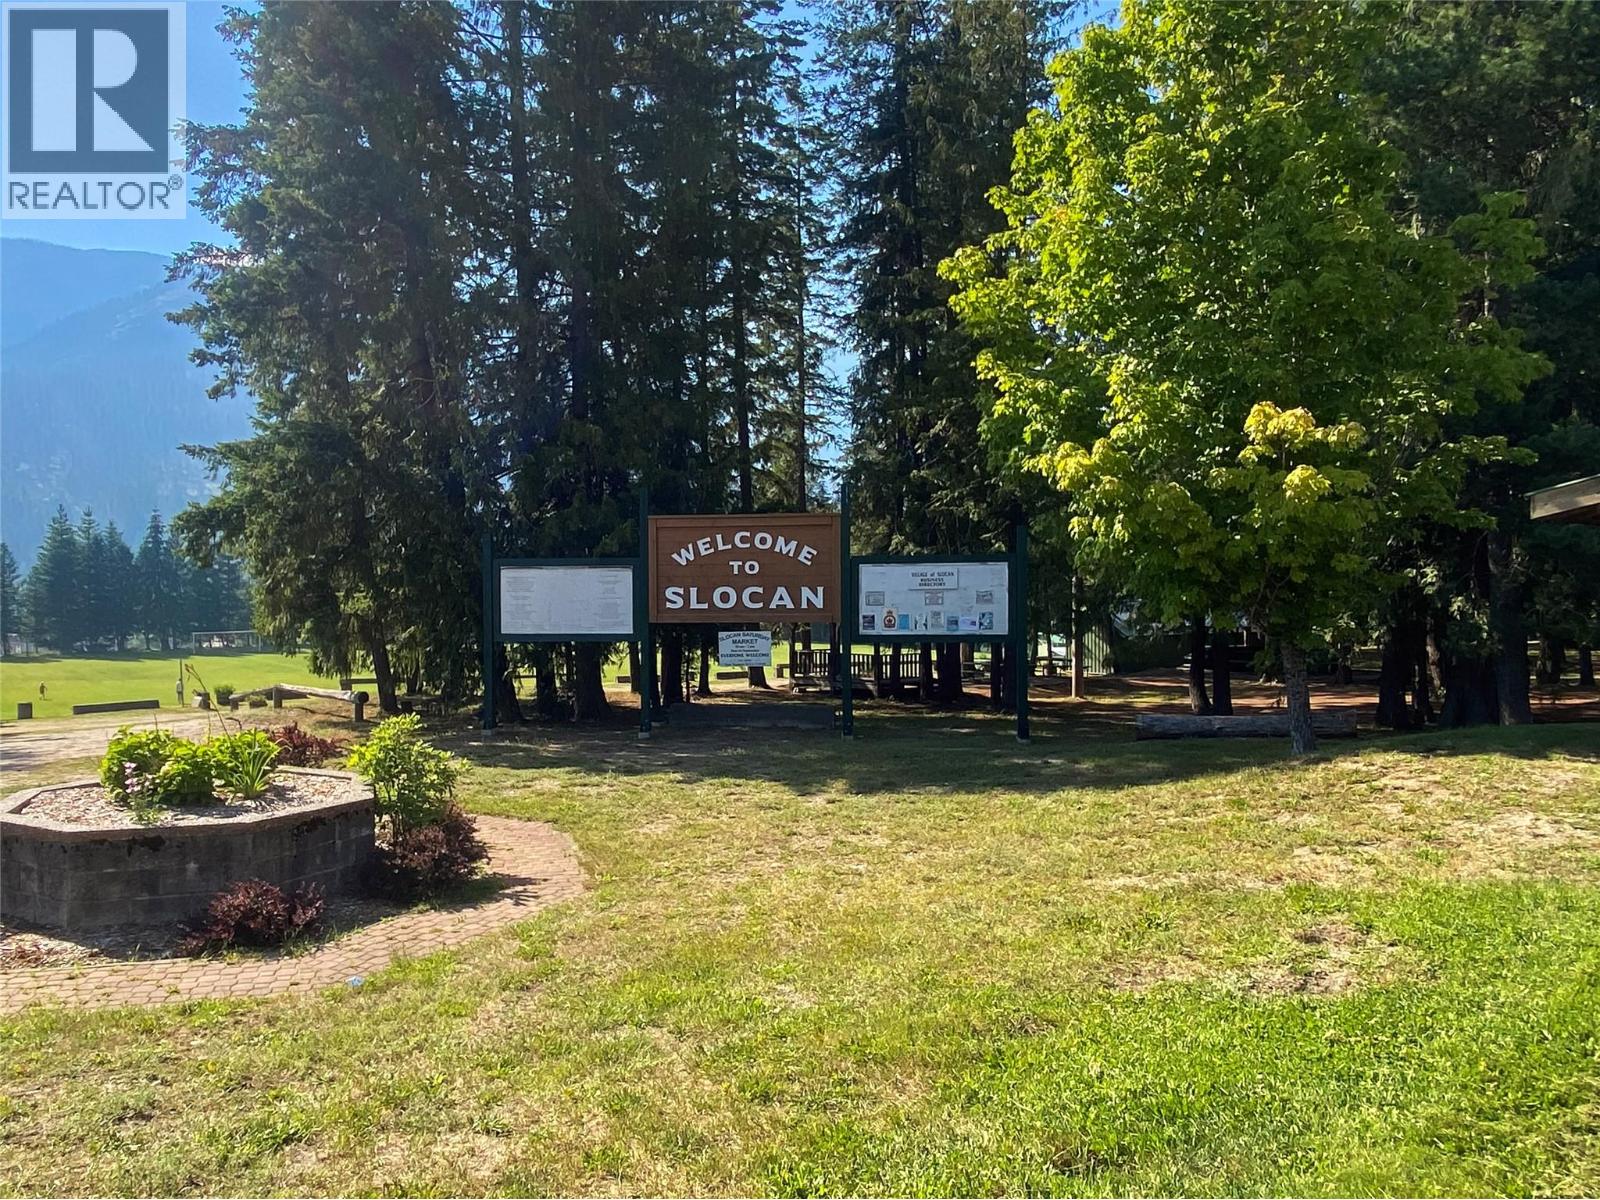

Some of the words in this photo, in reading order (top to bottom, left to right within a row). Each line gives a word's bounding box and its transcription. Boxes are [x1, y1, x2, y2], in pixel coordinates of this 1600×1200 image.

[671, 531, 818, 567] WELCOME
[728, 560, 760, 575] TO
[664, 586, 825, 610] SLOCAN
[719, 632, 742, 642] SLOCAN
[742, 632, 770, 641] SATURDAY
